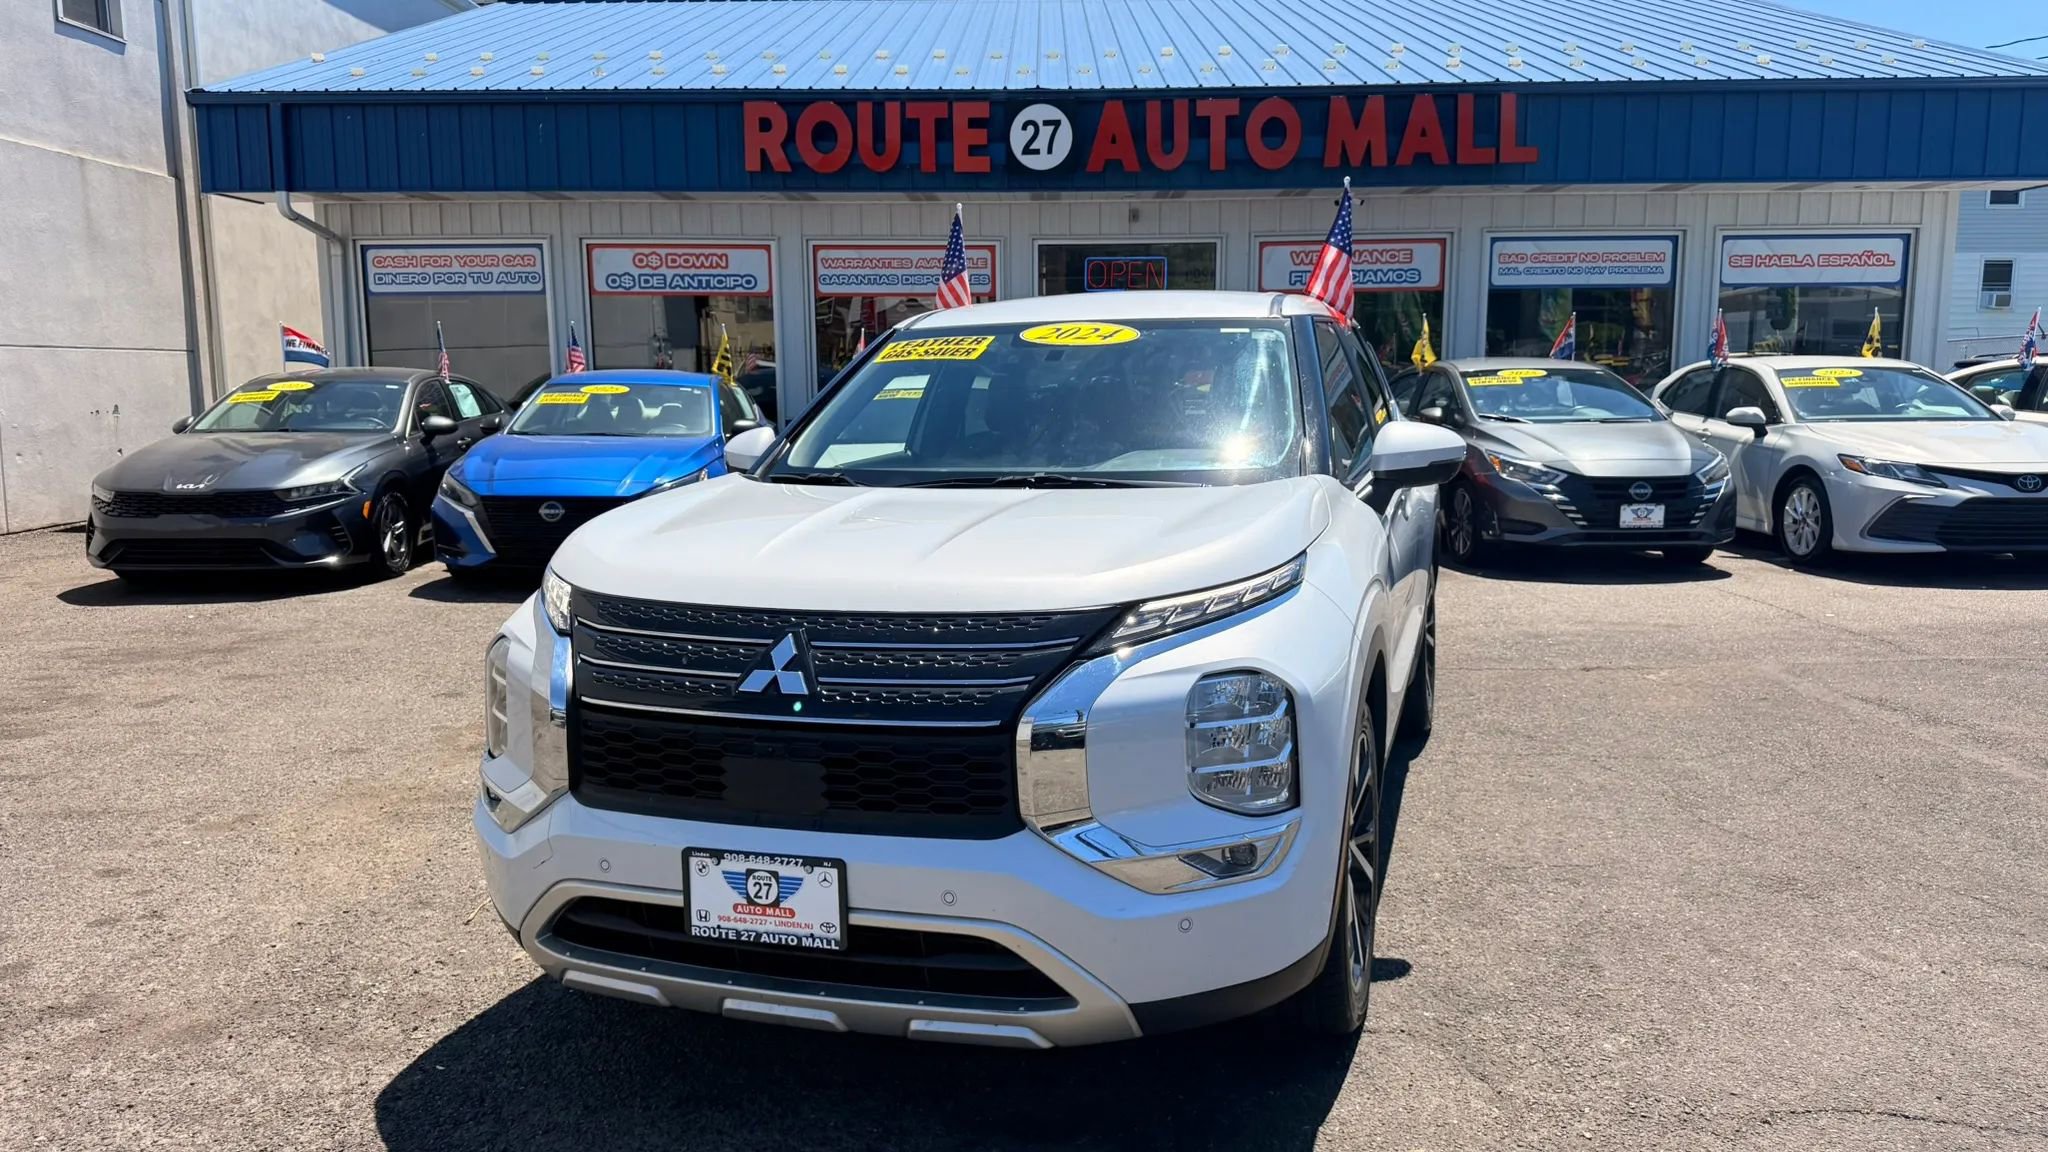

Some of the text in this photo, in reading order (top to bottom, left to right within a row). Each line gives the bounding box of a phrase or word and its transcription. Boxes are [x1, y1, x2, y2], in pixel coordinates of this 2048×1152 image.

[743, 93, 1538, 173] ROUTE 27 AUTO MALL
[373, 255, 536, 268] CASH FOR YOUR CAR
[666, 254, 728, 269] DOWN
[821, 257, 912, 269] WARRANTIES
[1499, 252, 1665, 263] BAD CREDIT NO PROBLEM
[1728, 250, 1895, 268] SE HABLA ESPAÑOL
[1088, 260, 1164, 288] OPEN
[1498, 266, 1664, 275] MAL CREDITO NO HAY PROBLEMA
[374, 272, 541, 285] DINERO POR TU AUTO
[638, 274, 666, 289] DE
[669, 274, 757, 290] ANTICIPO
[819, 274, 898, 286] GARANTIAS
[1034, 327, 1123, 340] 2024
[889, 337, 989, 350] LEATHER
[723, 852, 803, 867] 908-648-2727
[753, 882, 773, 900] 27
[736, 905, 793, 918] AUTO MALL
[717, 915, 768, 926] 908-648-2727
[691, 926, 840, 950] ROUTE 27 AUTO MALL
